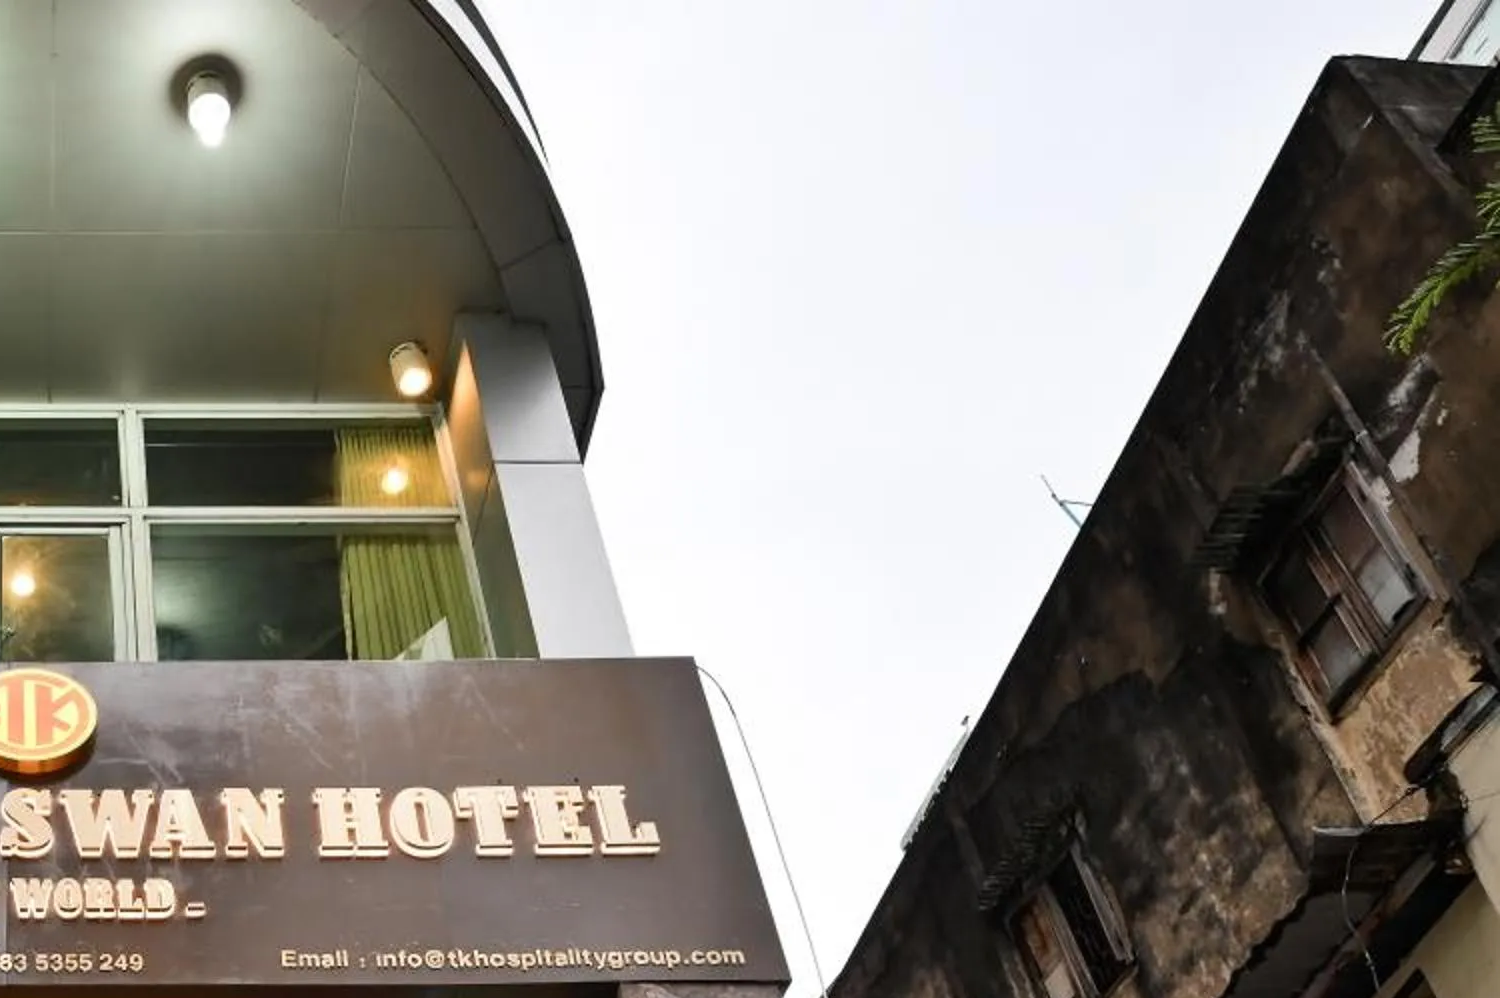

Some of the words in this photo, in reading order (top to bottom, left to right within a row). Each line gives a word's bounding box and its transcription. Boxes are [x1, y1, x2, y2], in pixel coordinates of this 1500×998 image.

[0, 787, 285, 859] SWAN
[312, 784, 661, 859] HOTEL
[10, 877, 177, 920] WORLD
[35, 954, 93, 972] 5355
[99, 953, 144, 972] 249
[281, 949, 349, 968] Email
[376, 947, 746, 972] info@tkhospitalitygroup.com
